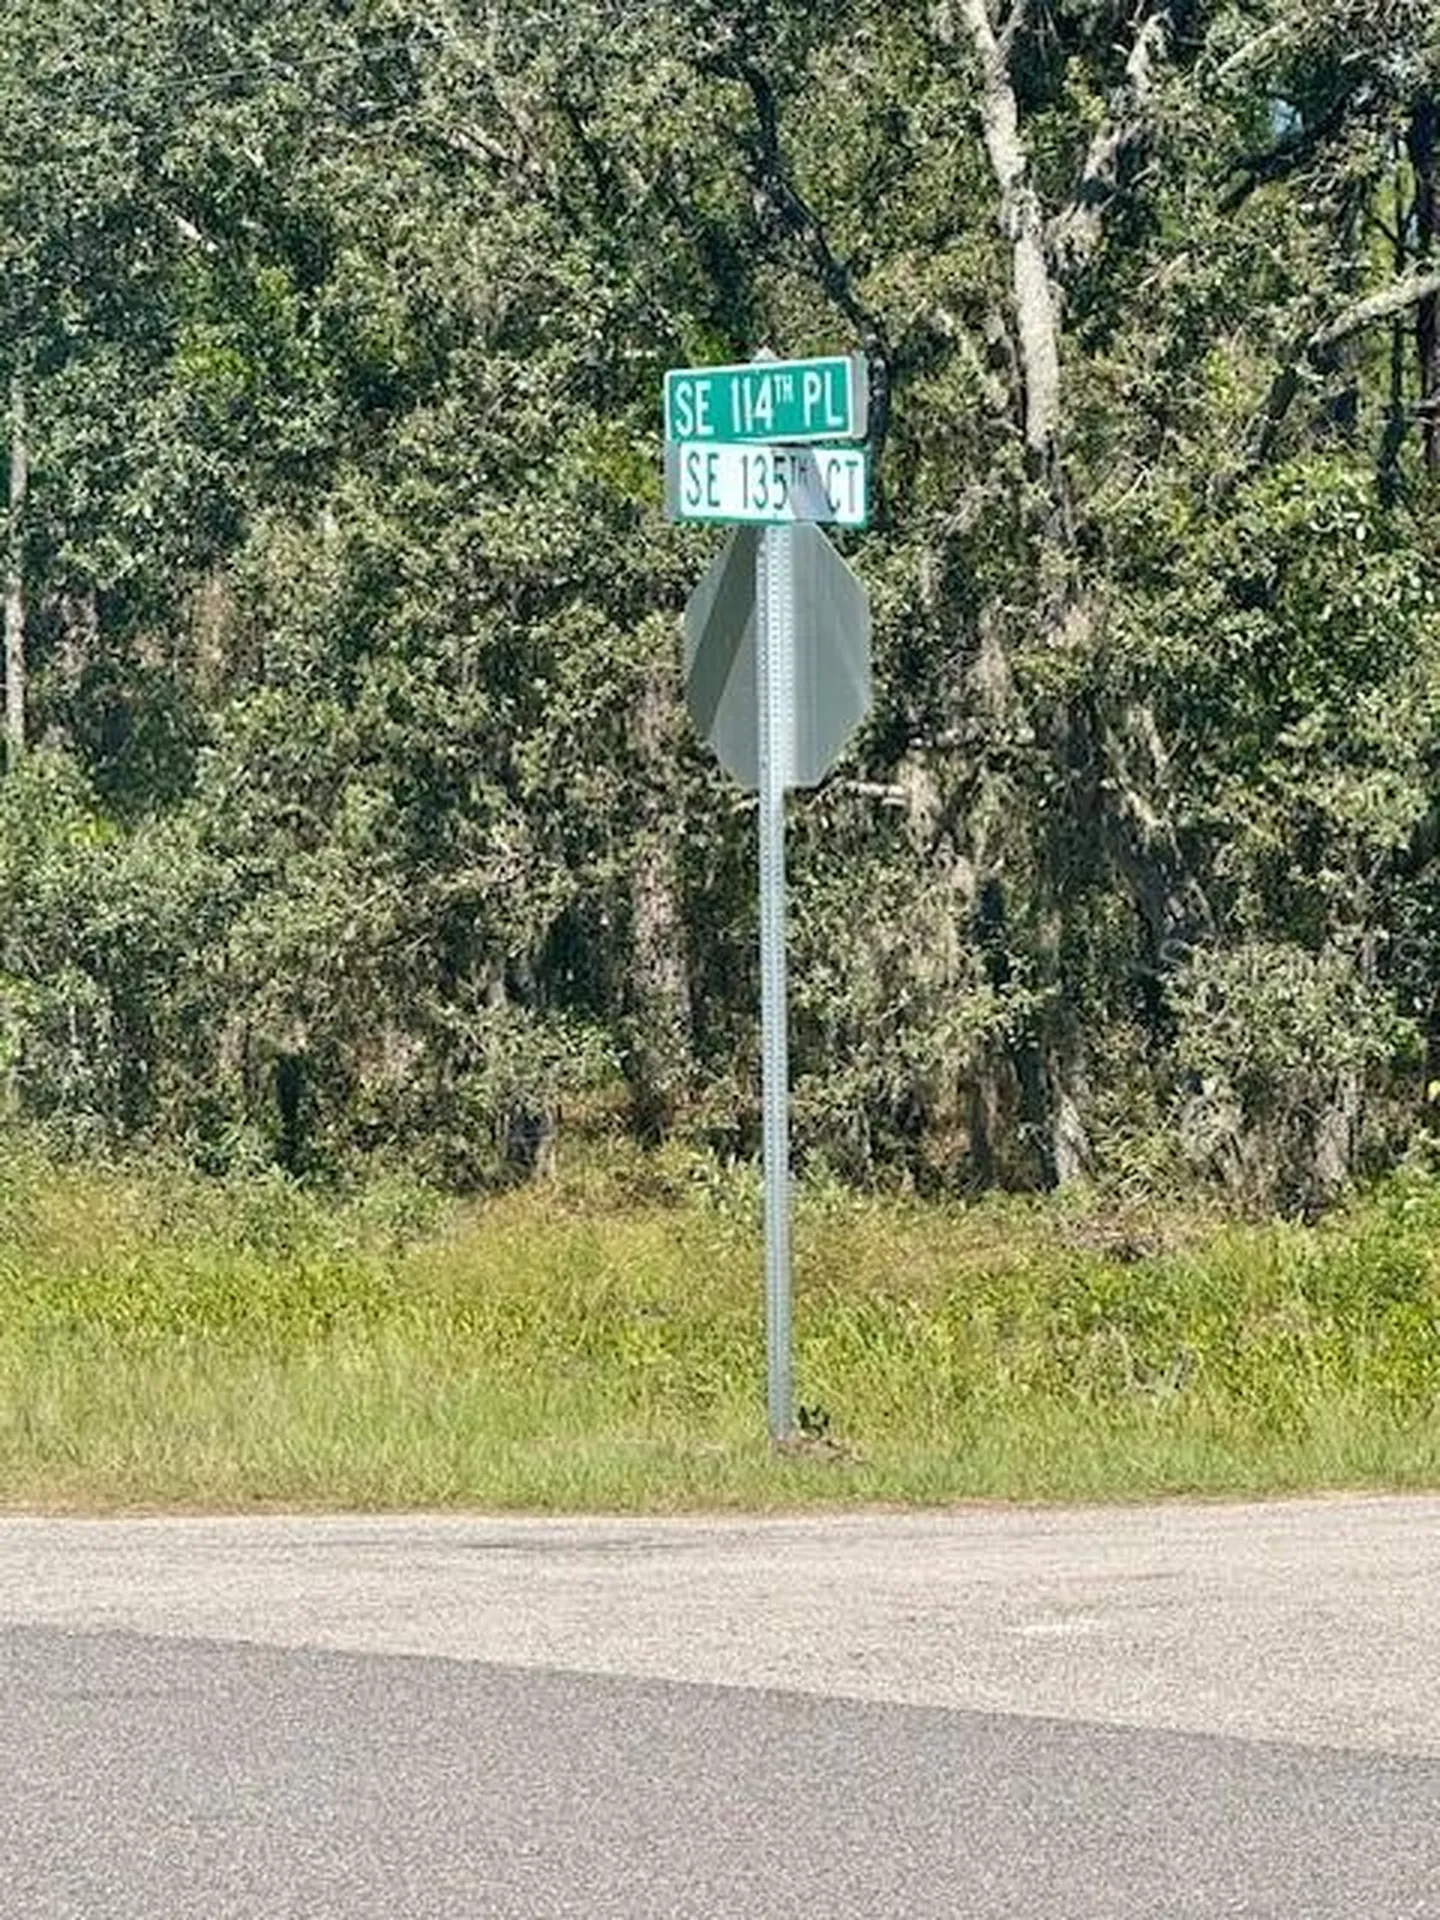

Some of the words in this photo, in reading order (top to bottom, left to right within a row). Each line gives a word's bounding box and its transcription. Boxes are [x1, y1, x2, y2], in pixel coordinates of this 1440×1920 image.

[675, 380, 714, 436] SE
[731, 374, 794, 433] 114TH
[803, 370, 843, 428] PL
[686, 451, 720, 507] SE
[742, 453, 809, 510] 135TH
[826, 458, 859, 514] CT
